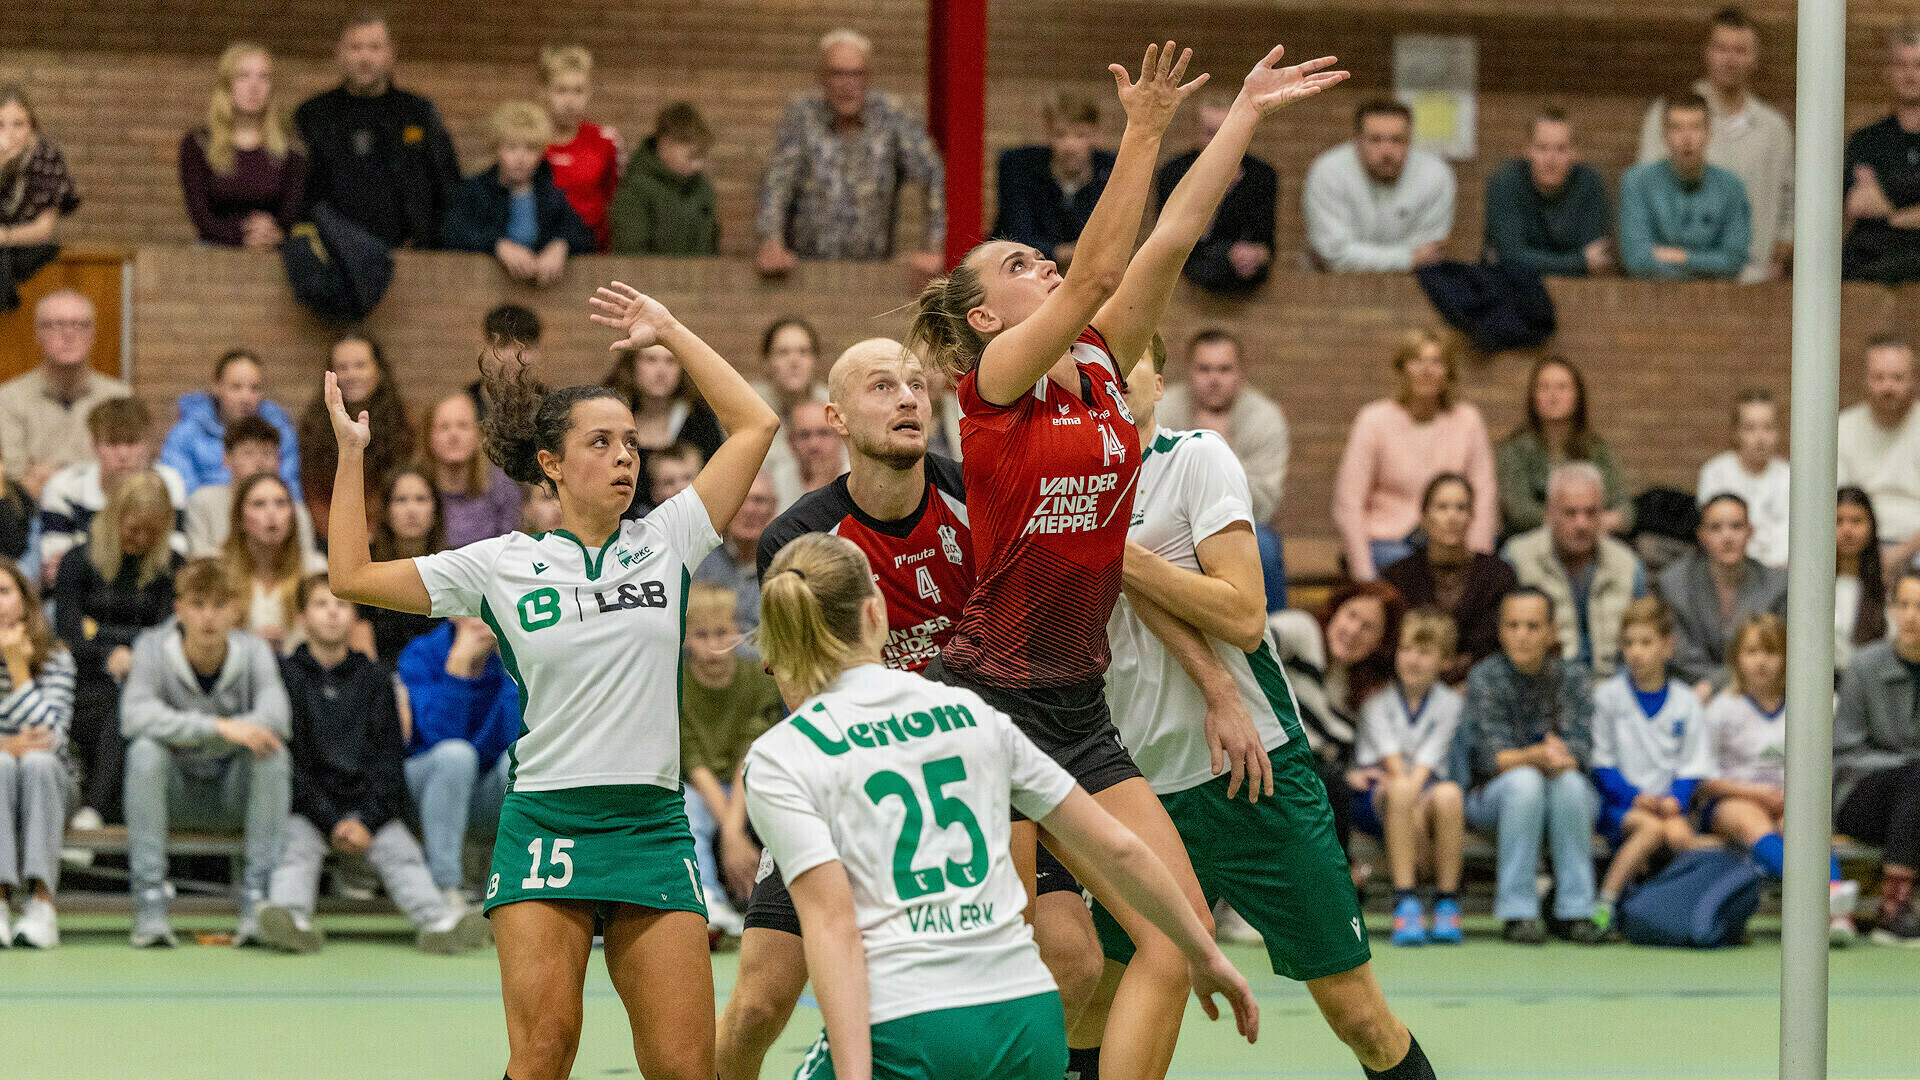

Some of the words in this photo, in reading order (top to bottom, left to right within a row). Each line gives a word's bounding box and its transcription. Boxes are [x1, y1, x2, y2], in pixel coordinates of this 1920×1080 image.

[1052, 416, 1081, 426] erima
[1097, 422, 1127, 467] 14
[1039, 476, 1085, 496] VAN
[1086, 472, 1118, 494] DER
[1032, 494, 1099, 516] LINDE
[1020, 512, 1098, 538] MEPPEL
[633, 546, 651, 560] PKC
[594, 580, 668, 613] L&B
[915, 565, 942, 605] 4
[911, 615, 952, 637] DER
[884, 635, 934, 660] INDE
[789, 702, 977, 756] Vertom
[864, 755, 989, 901] 25
[521, 837, 575, 889] 15
[906, 904, 955, 933] VAN
[960, 902, 995, 930] ERK
